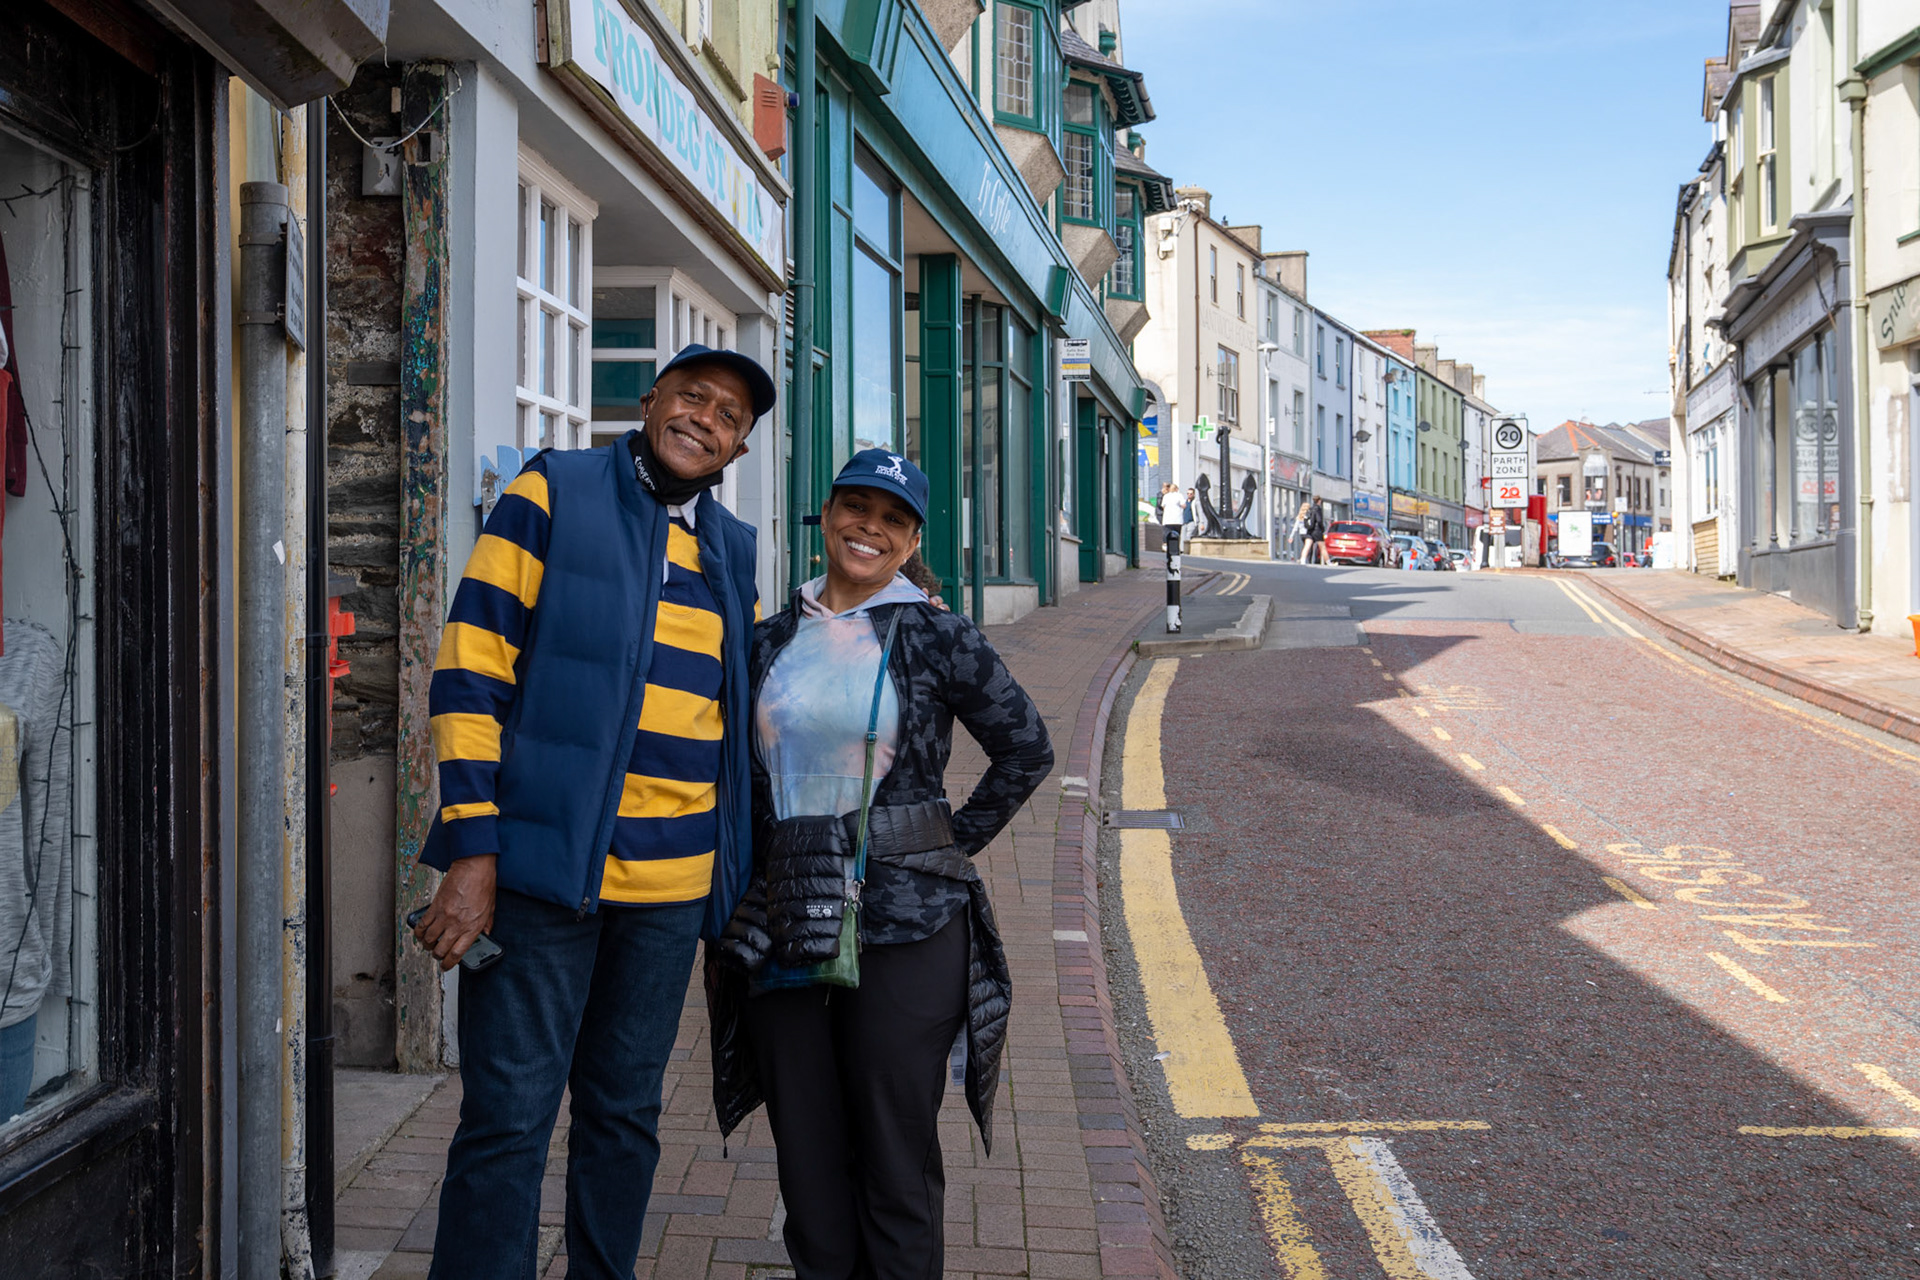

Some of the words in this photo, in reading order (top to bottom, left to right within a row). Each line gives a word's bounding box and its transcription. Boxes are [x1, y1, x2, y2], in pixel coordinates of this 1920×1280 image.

[1501, 430, 1519, 442] 20
[1493, 456, 1526, 464] PARTH
[1496, 466, 1523, 474] ZONE
[1500, 486, 1521, 499] 20
[1605, 842, 1880, 956] TACSIS
